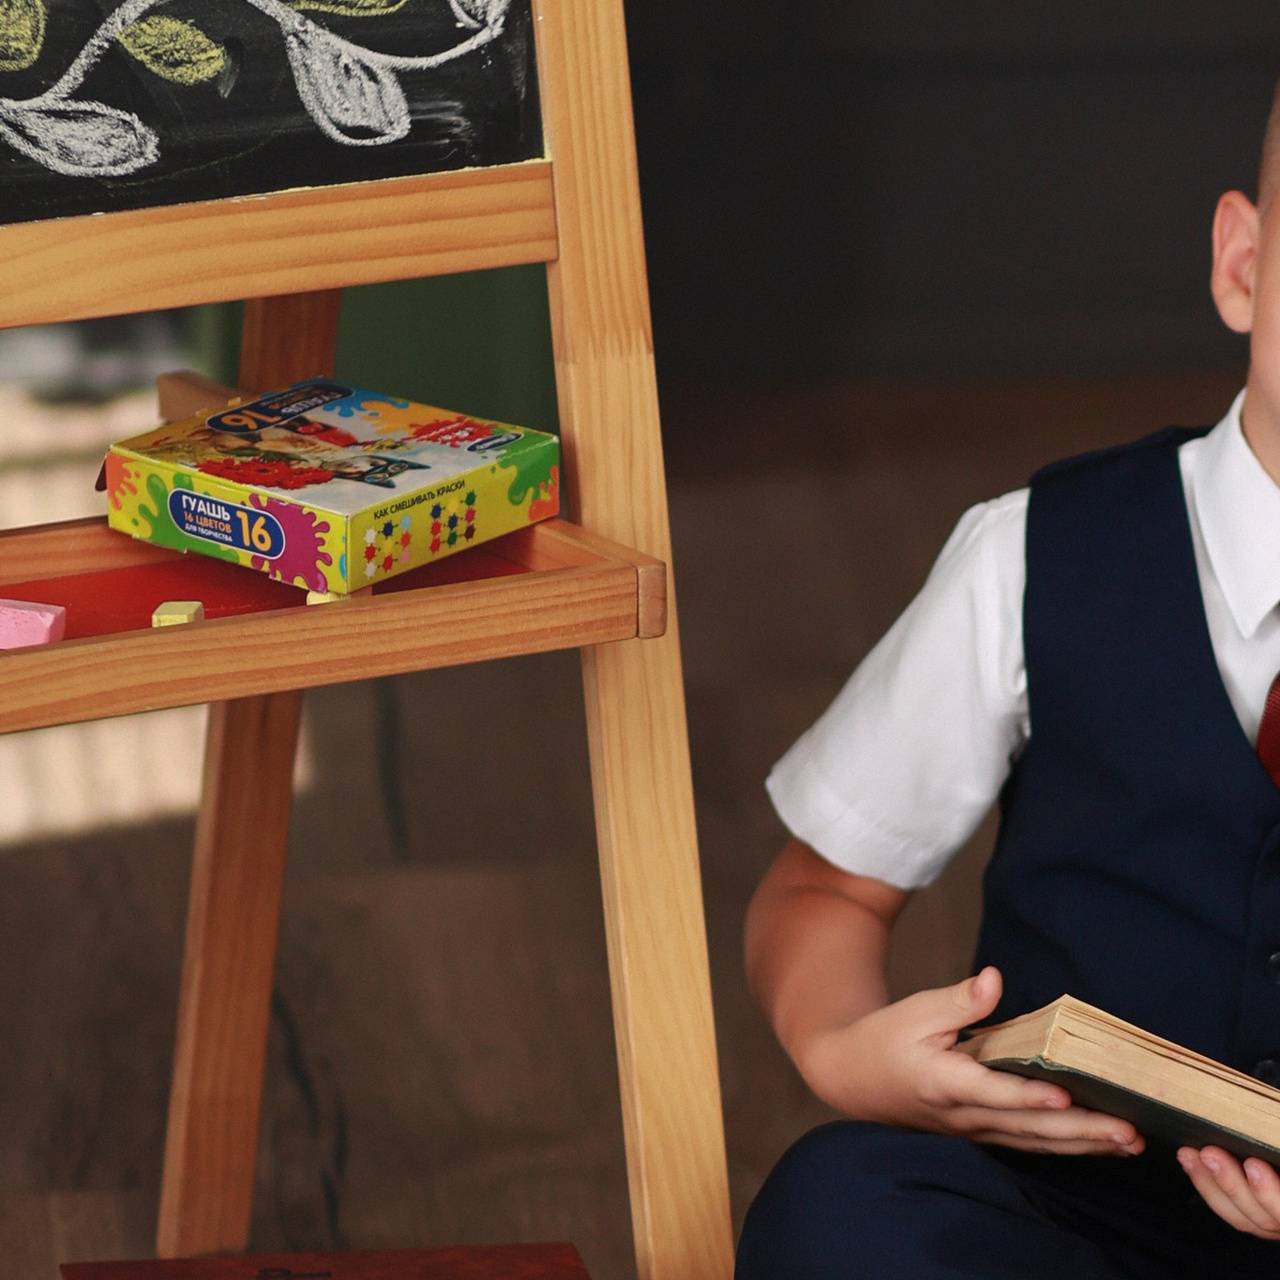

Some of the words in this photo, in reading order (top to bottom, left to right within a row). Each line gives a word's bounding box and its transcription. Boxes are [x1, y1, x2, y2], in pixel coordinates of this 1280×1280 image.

[181, 494, 231, 521] ГУАШЬ
[373, 508, 389, 520] КАК
[390, 490, 435, 514] СМЕШИВАТЬ
[436, 479, 466, 497] КРАСКИ
[184, 510, 194, 523] 16
[195, 513, 233, 534] ЦВЕТОВ
[236, 510, 272, 552] 16
